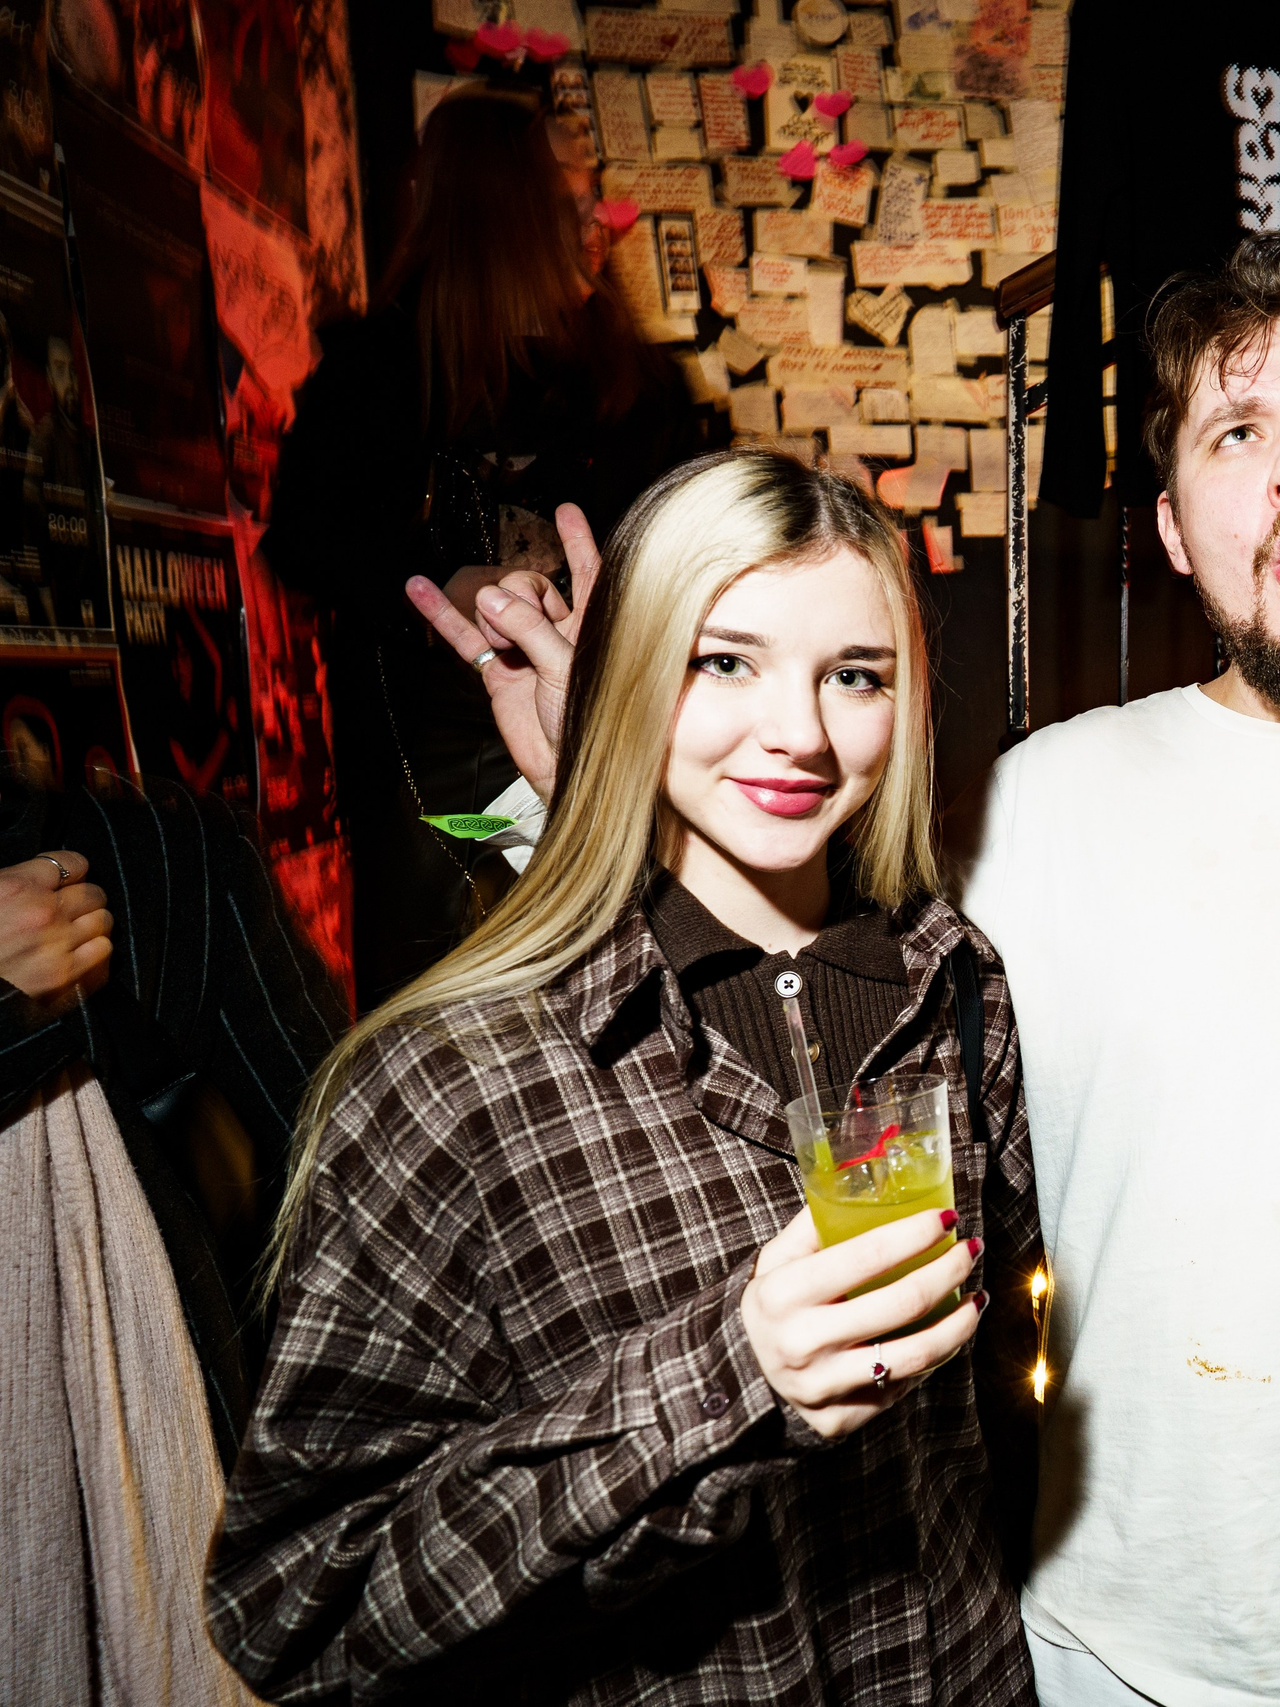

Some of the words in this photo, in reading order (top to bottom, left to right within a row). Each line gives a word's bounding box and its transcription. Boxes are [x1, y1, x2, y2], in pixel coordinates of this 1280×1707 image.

[48, 513, 88, 540] 20:00
[116, 544, 228, 612] HALLOWEEN
[123, 599, 168, 647] PARTY
